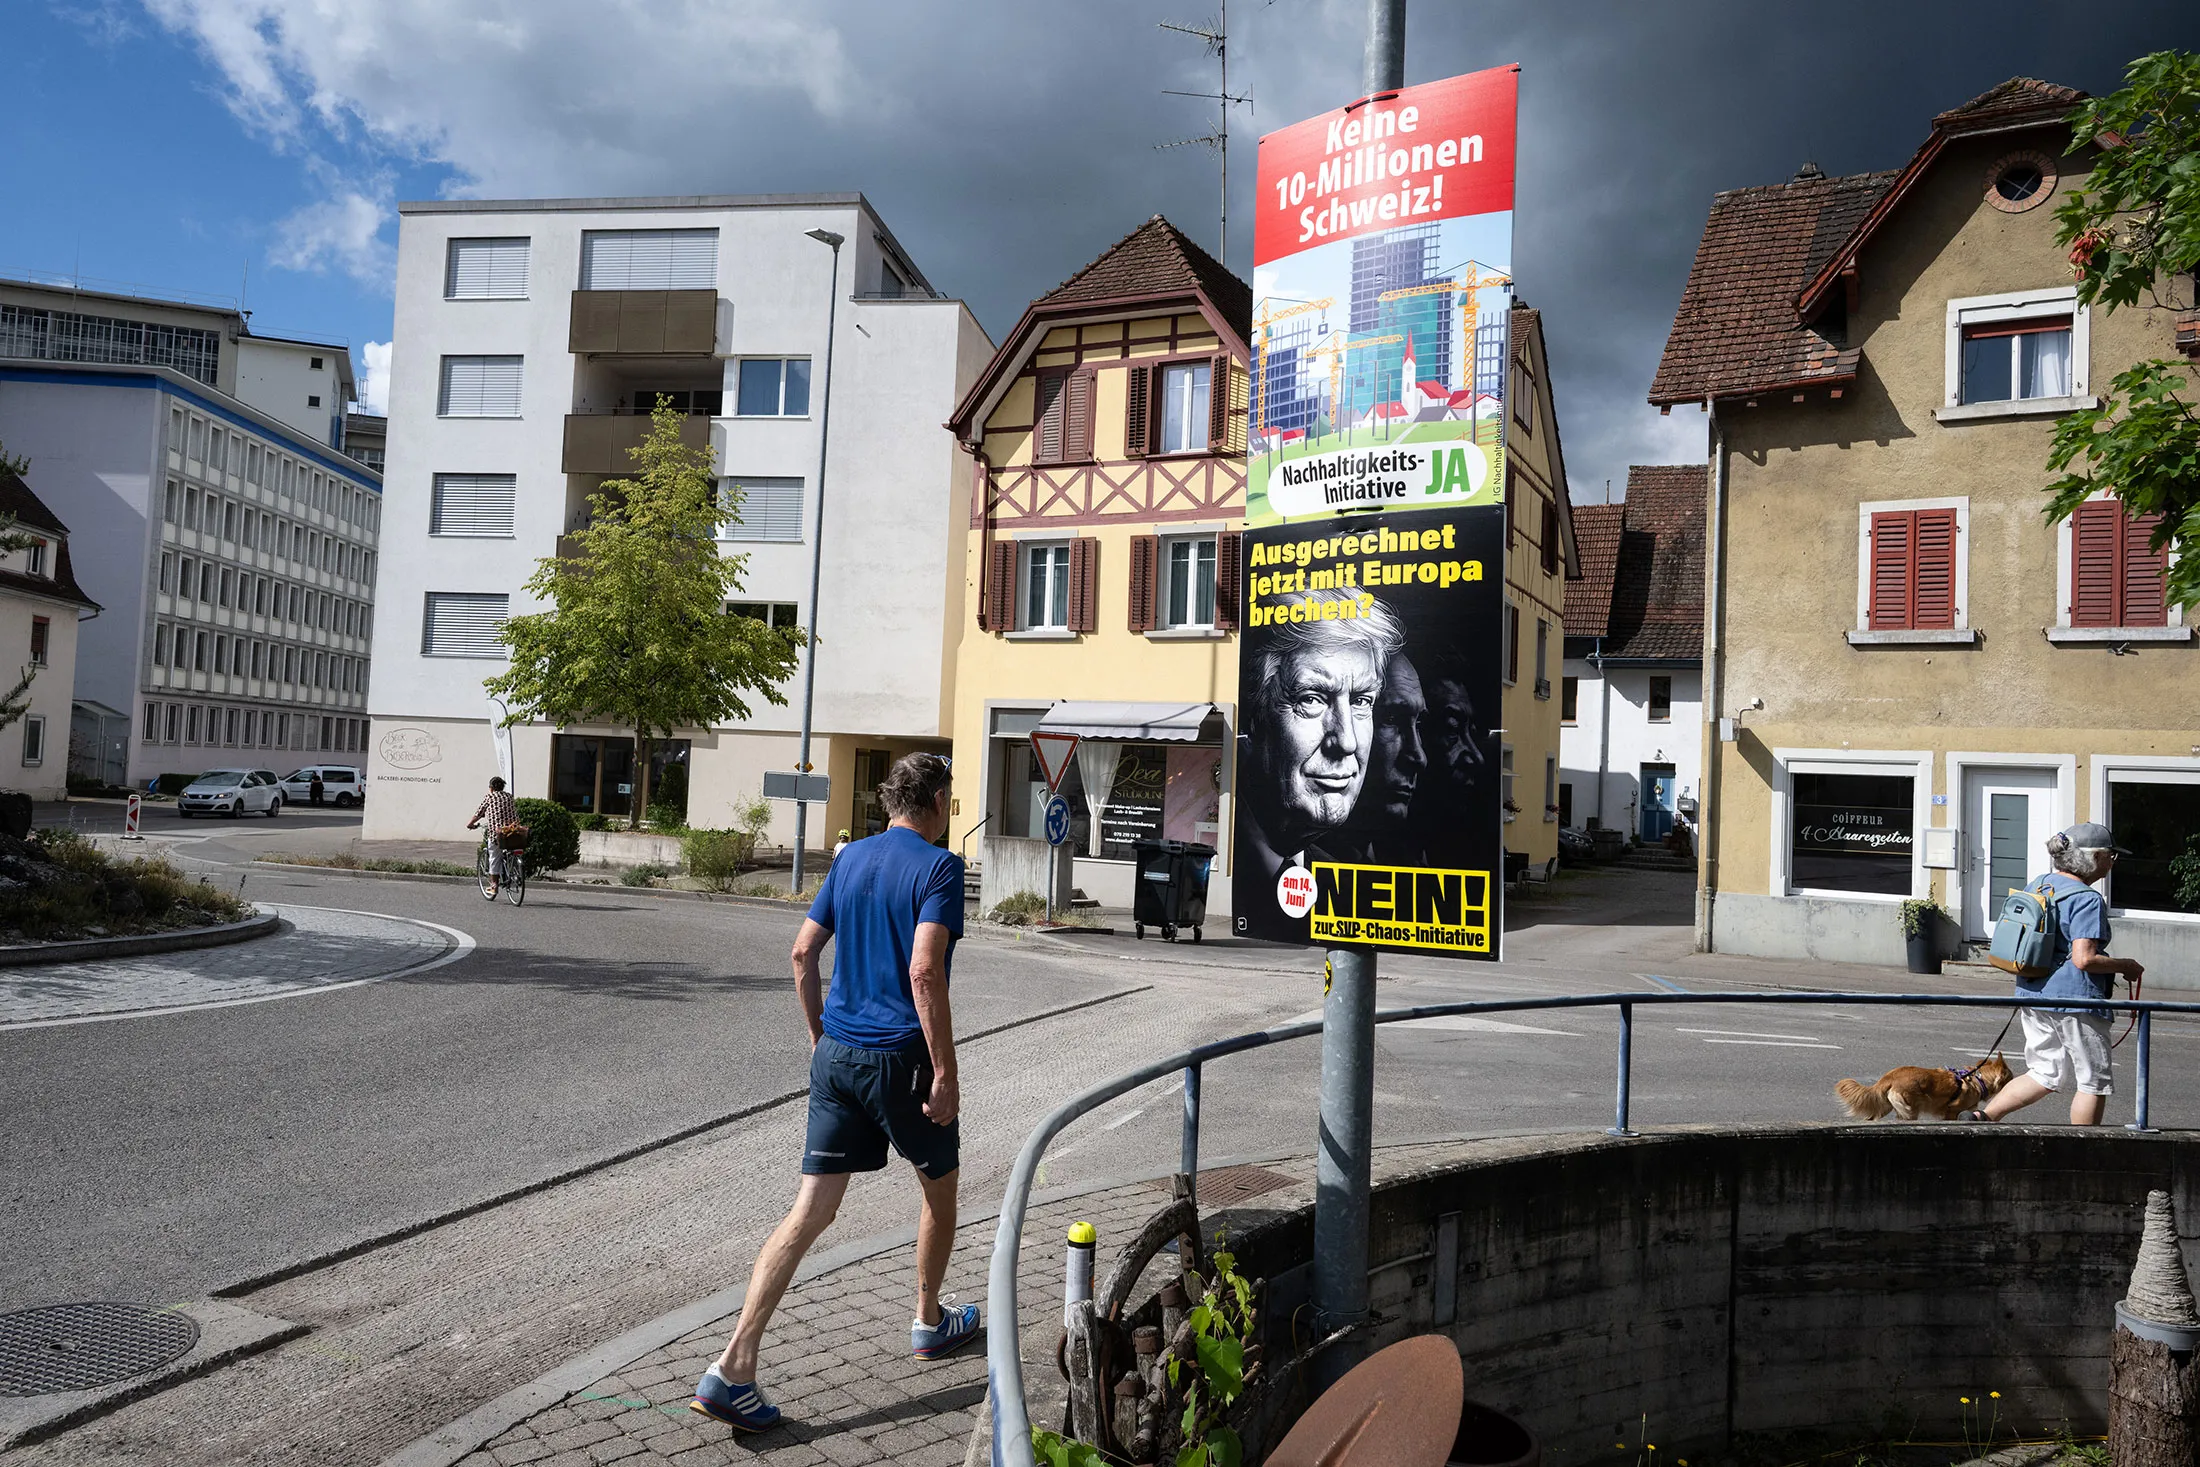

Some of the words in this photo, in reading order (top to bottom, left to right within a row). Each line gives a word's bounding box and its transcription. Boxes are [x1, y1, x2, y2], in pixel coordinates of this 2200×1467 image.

[1325, 104, 1419, 155] Keine
[1275, 134, 1483, 211] 10-Millionen
[1298, 174, 1444, 243] Schweiz!
[1282, 449, 1425, 487] Nachhaltigkeits-
[1425, 448, 1471, 495] JA
[1323, 476, 1407, 504] Initiative
[1250, 524, 1456, 567] Ausgerechnet
[1249, 569, 1306, 602] jetzt
[1310, 562, 1357, 592] mit
[1362, 559, 1483, 588] Europa
[1249, 592, 1375, 627] brechen?
[1283, 876, 1298, 890] am
[1299, 877, 1313, 892] 14.
[1285, 891, 1306, 908] Juni
[1315, 866, 1486, 927] NEIN!
[1314, 920, 1334, 936] zur
[1336, 920, 1485, 947] SVP-Chaos-Initiative
